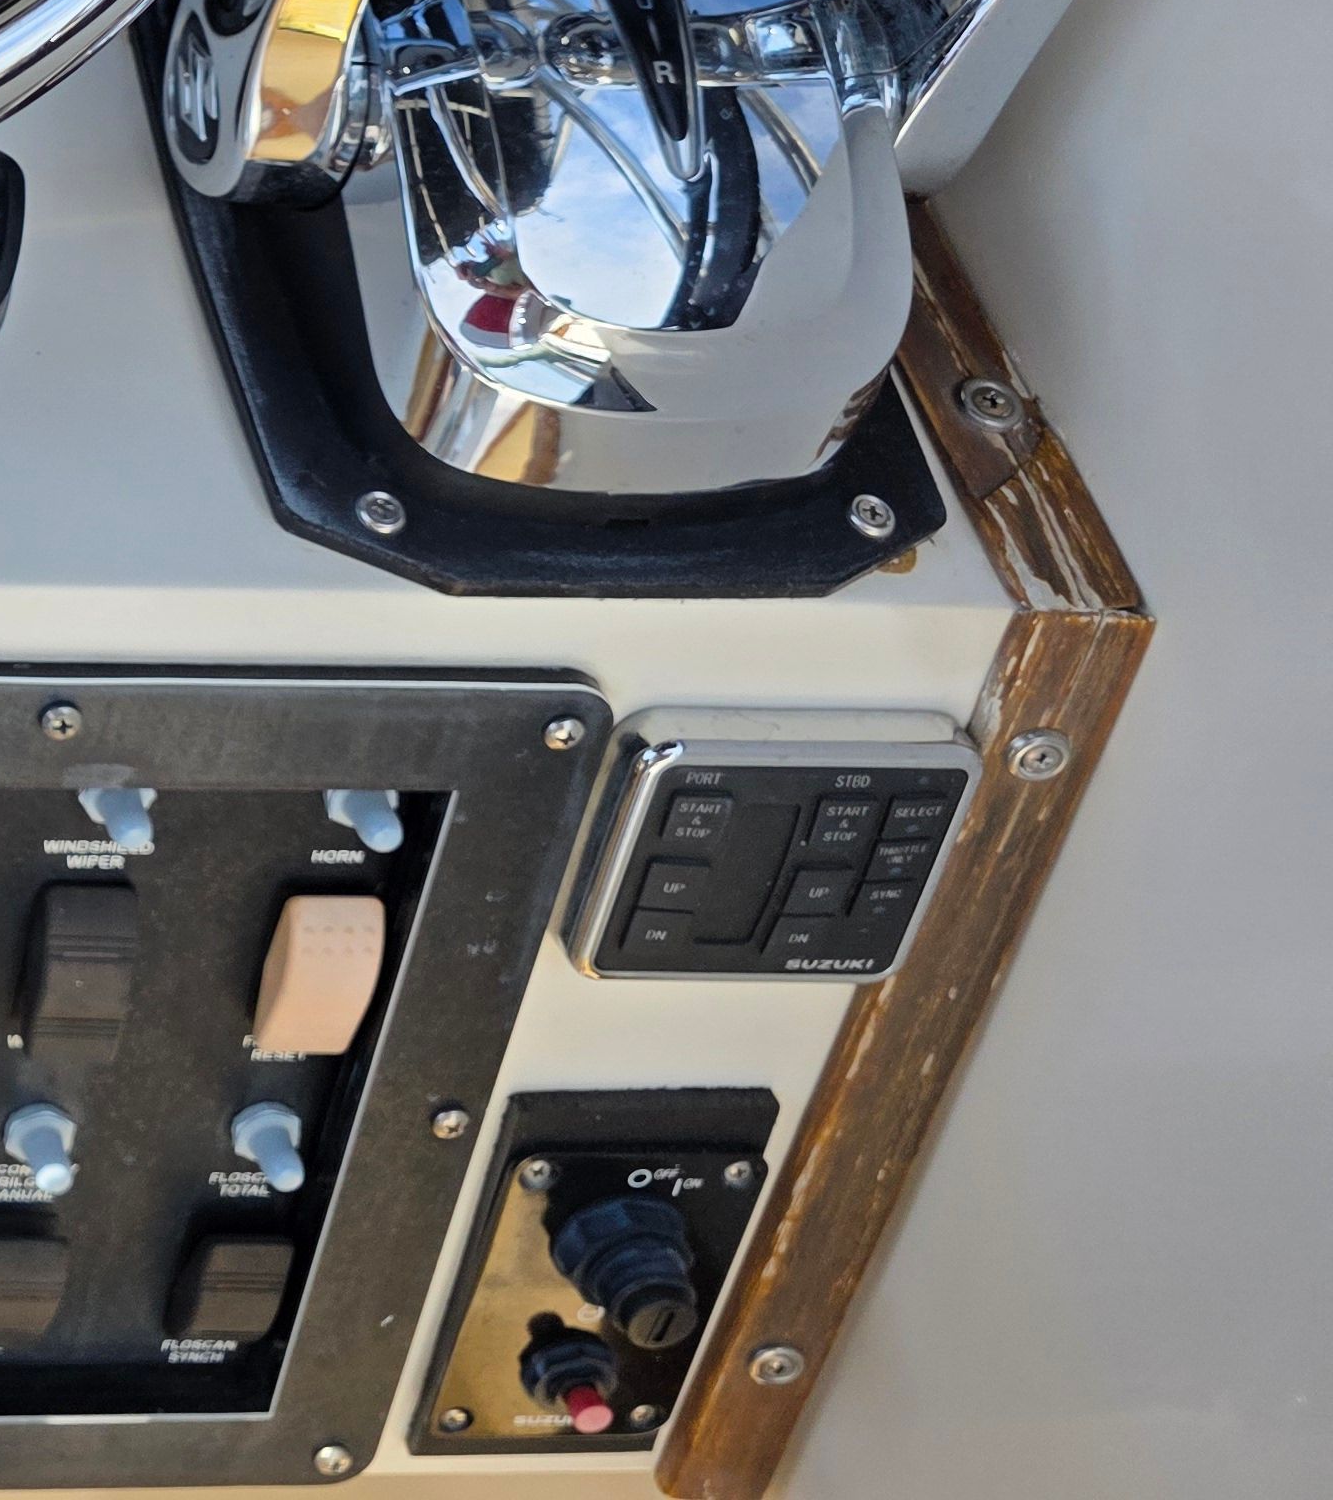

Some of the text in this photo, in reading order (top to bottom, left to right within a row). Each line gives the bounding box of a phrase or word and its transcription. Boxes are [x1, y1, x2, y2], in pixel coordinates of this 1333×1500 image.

[652, 60, 678, 85] R
[685, 771, 871, 789] PORT STBD
[678, 801, 723, 816] START
[825, 804, 870, 818] START
[894, 805, 945, 820] SELECT
[675, 826, 713, 839] STOP
[821, 829, 859, 843] STOP
[65, 853, 126, 870] WIPER
[310, 848, 366, 865] HORN
[662, 881, 687, 895] UP
[808, 886, 831, 900] UP
[869, 887, 903, 901] SYNC
[645, 929, 668, 941] DN
[788, 932, 811, 944] DN
[784, 957, 876, 972] SUZUKI
[250, 1047, 306, 1064] RESET
[208, 1170, 268, 1187] FLOSC
[653, 1166, 680, 1181] OFF
[218, 1182, 272, 1199] TOTAL
[683, 1177, 705, 1191] ON
[160, 1338, 239, 1354] FLOSCAN
[167, 1350, 225, 1364] SYNCH
[512, 1413, 576, 1428] SUZU
